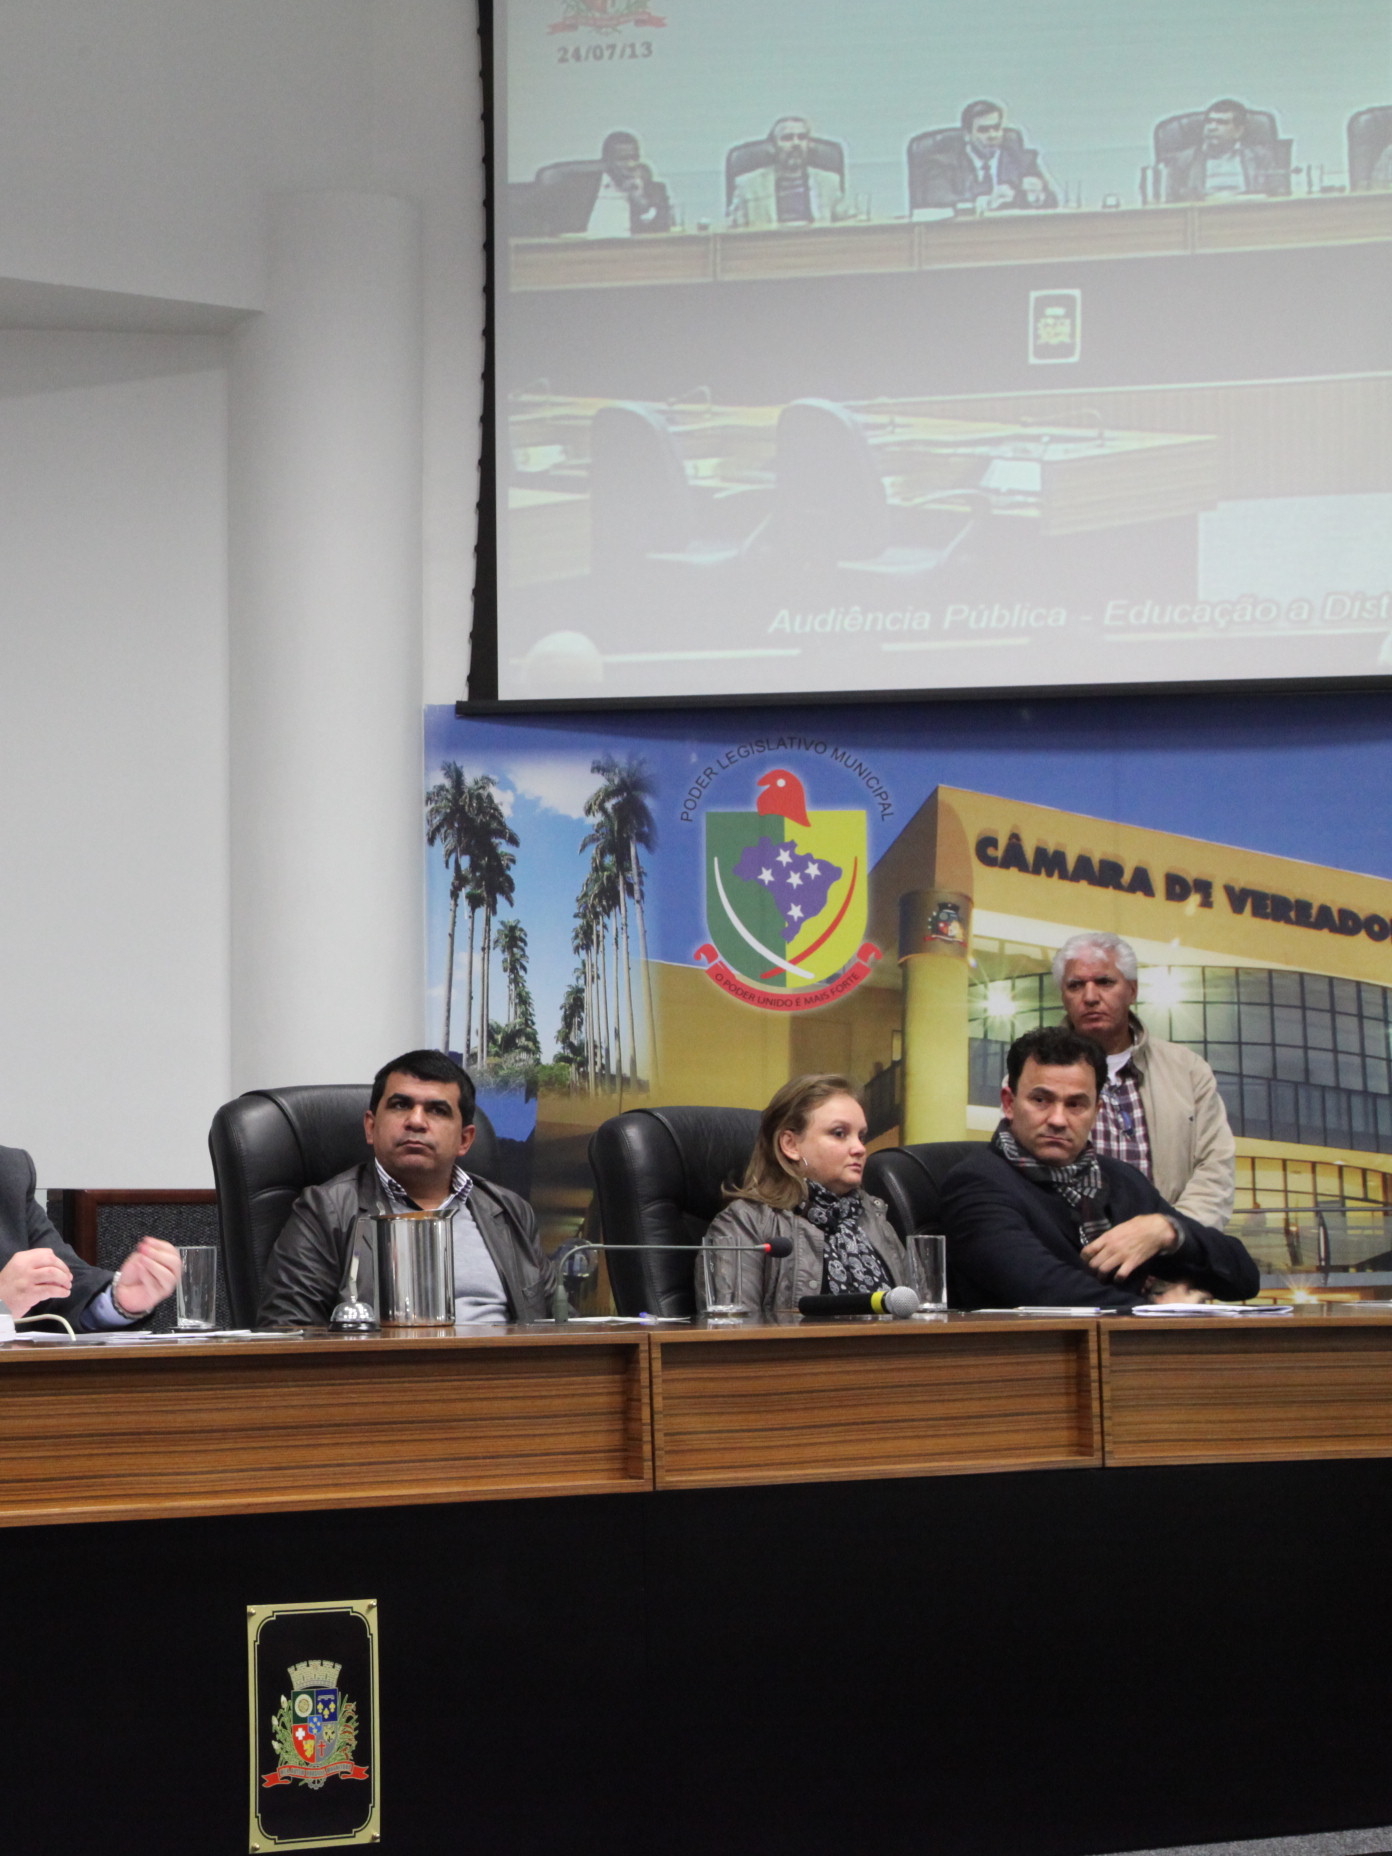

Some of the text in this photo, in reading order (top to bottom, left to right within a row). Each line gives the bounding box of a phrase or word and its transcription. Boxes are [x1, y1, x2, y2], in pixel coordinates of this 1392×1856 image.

[557, 41, 654, 64] 24/07/13
[767, 605, 932, 634] Audiência
[943, 602, 1068, 629] Pública
[1103, 595, 1277, 628] Educação
[680, 736, 895, 822] PODER LEGISLATIVO MUNICIPAL
[975, 832, 1392, 942] CÂMARA DE VEREADO
[715, 973, 723, 982] O
[723, 979, 755, 1001] PODER
[757, 995, 793, 1007] UNIDO
[804, 991, 830, 1005] MAIS
[830, 972, 859, 995] FORTE
